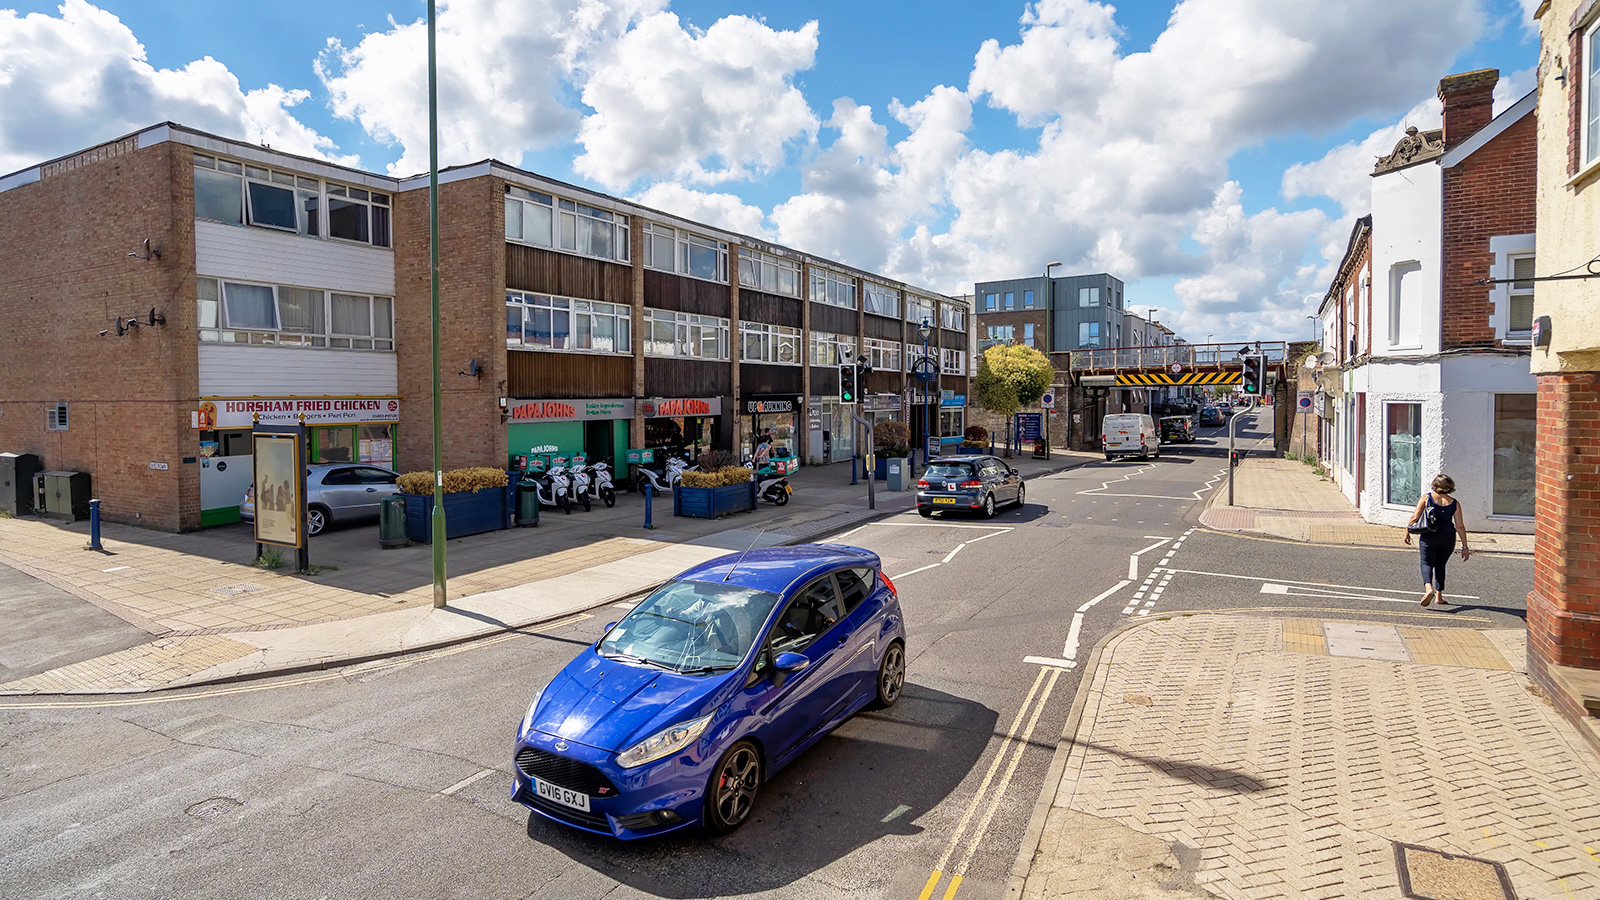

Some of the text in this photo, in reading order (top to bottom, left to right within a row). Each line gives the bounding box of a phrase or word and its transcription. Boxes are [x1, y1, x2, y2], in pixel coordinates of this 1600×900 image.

[226, 400, 380, 412] HORSHAM FRIED CHICKEN
[540, 782, 585, 808] GV16 GXJ
